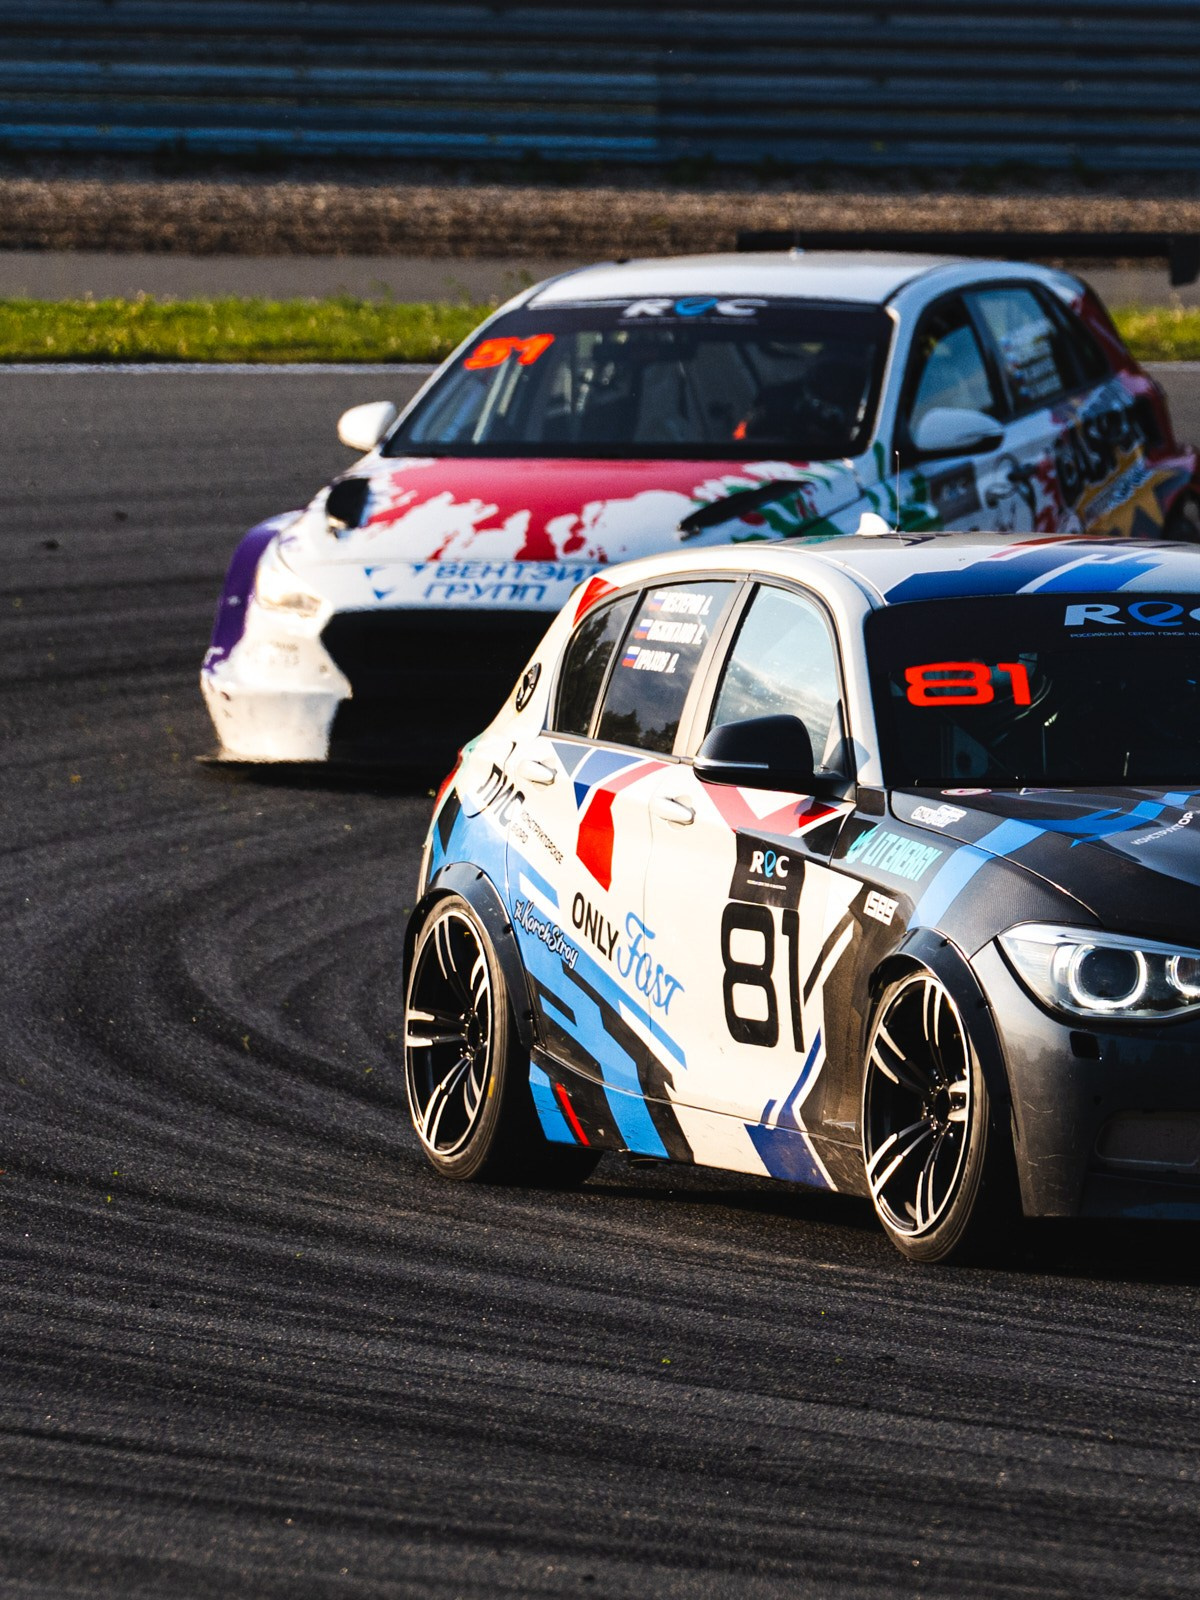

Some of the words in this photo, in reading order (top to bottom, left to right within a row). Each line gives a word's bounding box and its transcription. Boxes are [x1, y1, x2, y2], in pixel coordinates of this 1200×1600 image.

[424, 583, 547, 600] ГРУПП
[904, 661, 1031, 707] 81
[571, 891, 619, 962] ONLY
[720, 901, 805, 1054] 81
